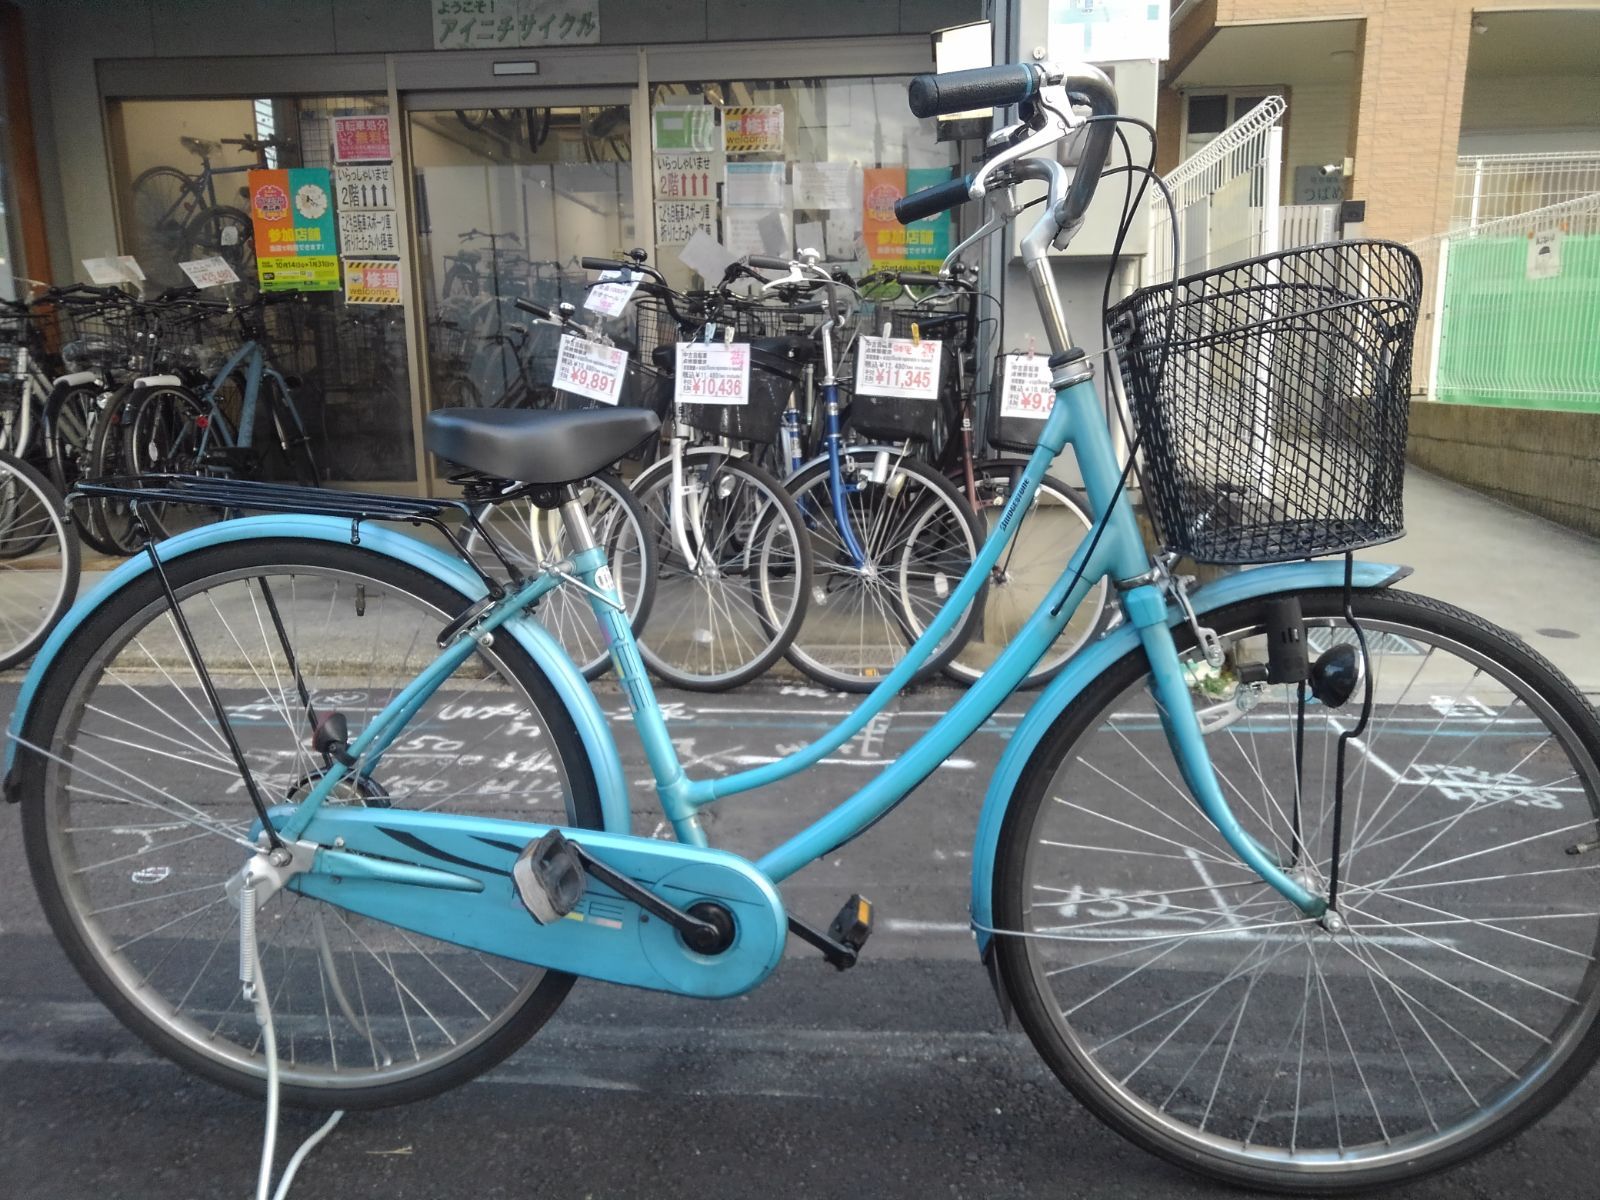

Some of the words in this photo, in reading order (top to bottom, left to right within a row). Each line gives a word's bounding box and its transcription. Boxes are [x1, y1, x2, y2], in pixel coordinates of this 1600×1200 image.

[439, 12, 595, 43] アイニチサイクル
[336, 120, 387, 132] 自転車処分
[657, 156, 711, 170] いらっしゃいませ
[338, 168, 389, 182] いらっしゃいませ
[660, 173, 679, 196] 2階
[341, 186, 360, 206] 2階
[267, 227, 321, 243] 参加店舗
[365, 270, 399, 288] 修理
[349, 286, 391, 296] welcome
[571, 368, 616, 394] ¥9,891
[692, 376, 742, 396] ¥10,436
[875, 368, 931, 388] ¥11,345
